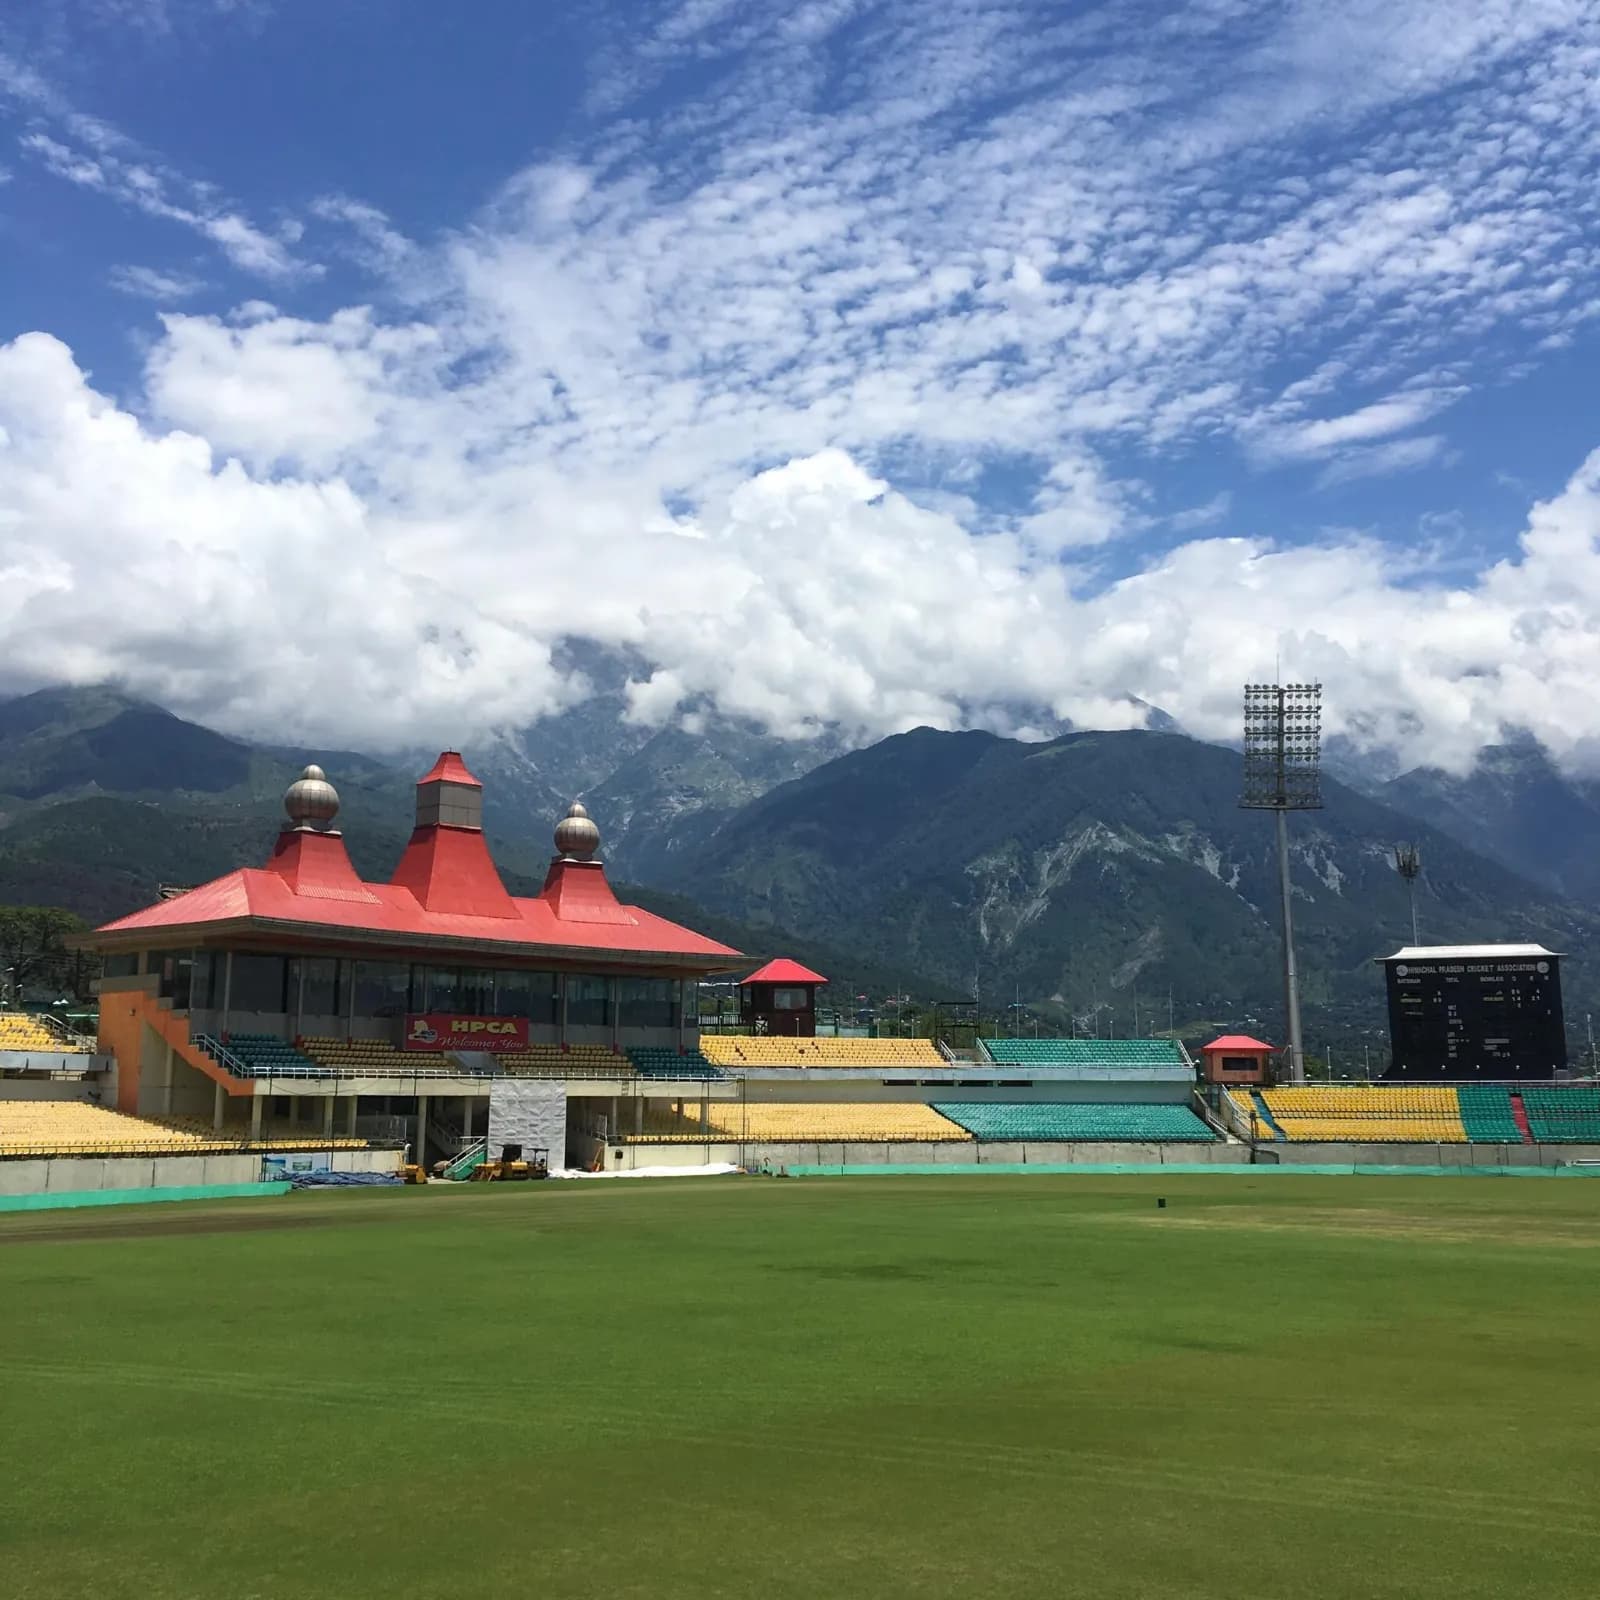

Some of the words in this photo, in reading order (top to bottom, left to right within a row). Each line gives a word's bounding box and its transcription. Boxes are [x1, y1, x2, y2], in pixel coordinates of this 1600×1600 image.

[1407, 966, 1437, 974] HIMACHAL
[1438, 965, 1465, 973] PRADESH
[1467, 964, 1495, 973] CRICKET
[1497, 963, 1536, 973] ASSOCIATION
[451, 1020, 518, 1034] HPCA
[499, 1038, 524, 1049] You
